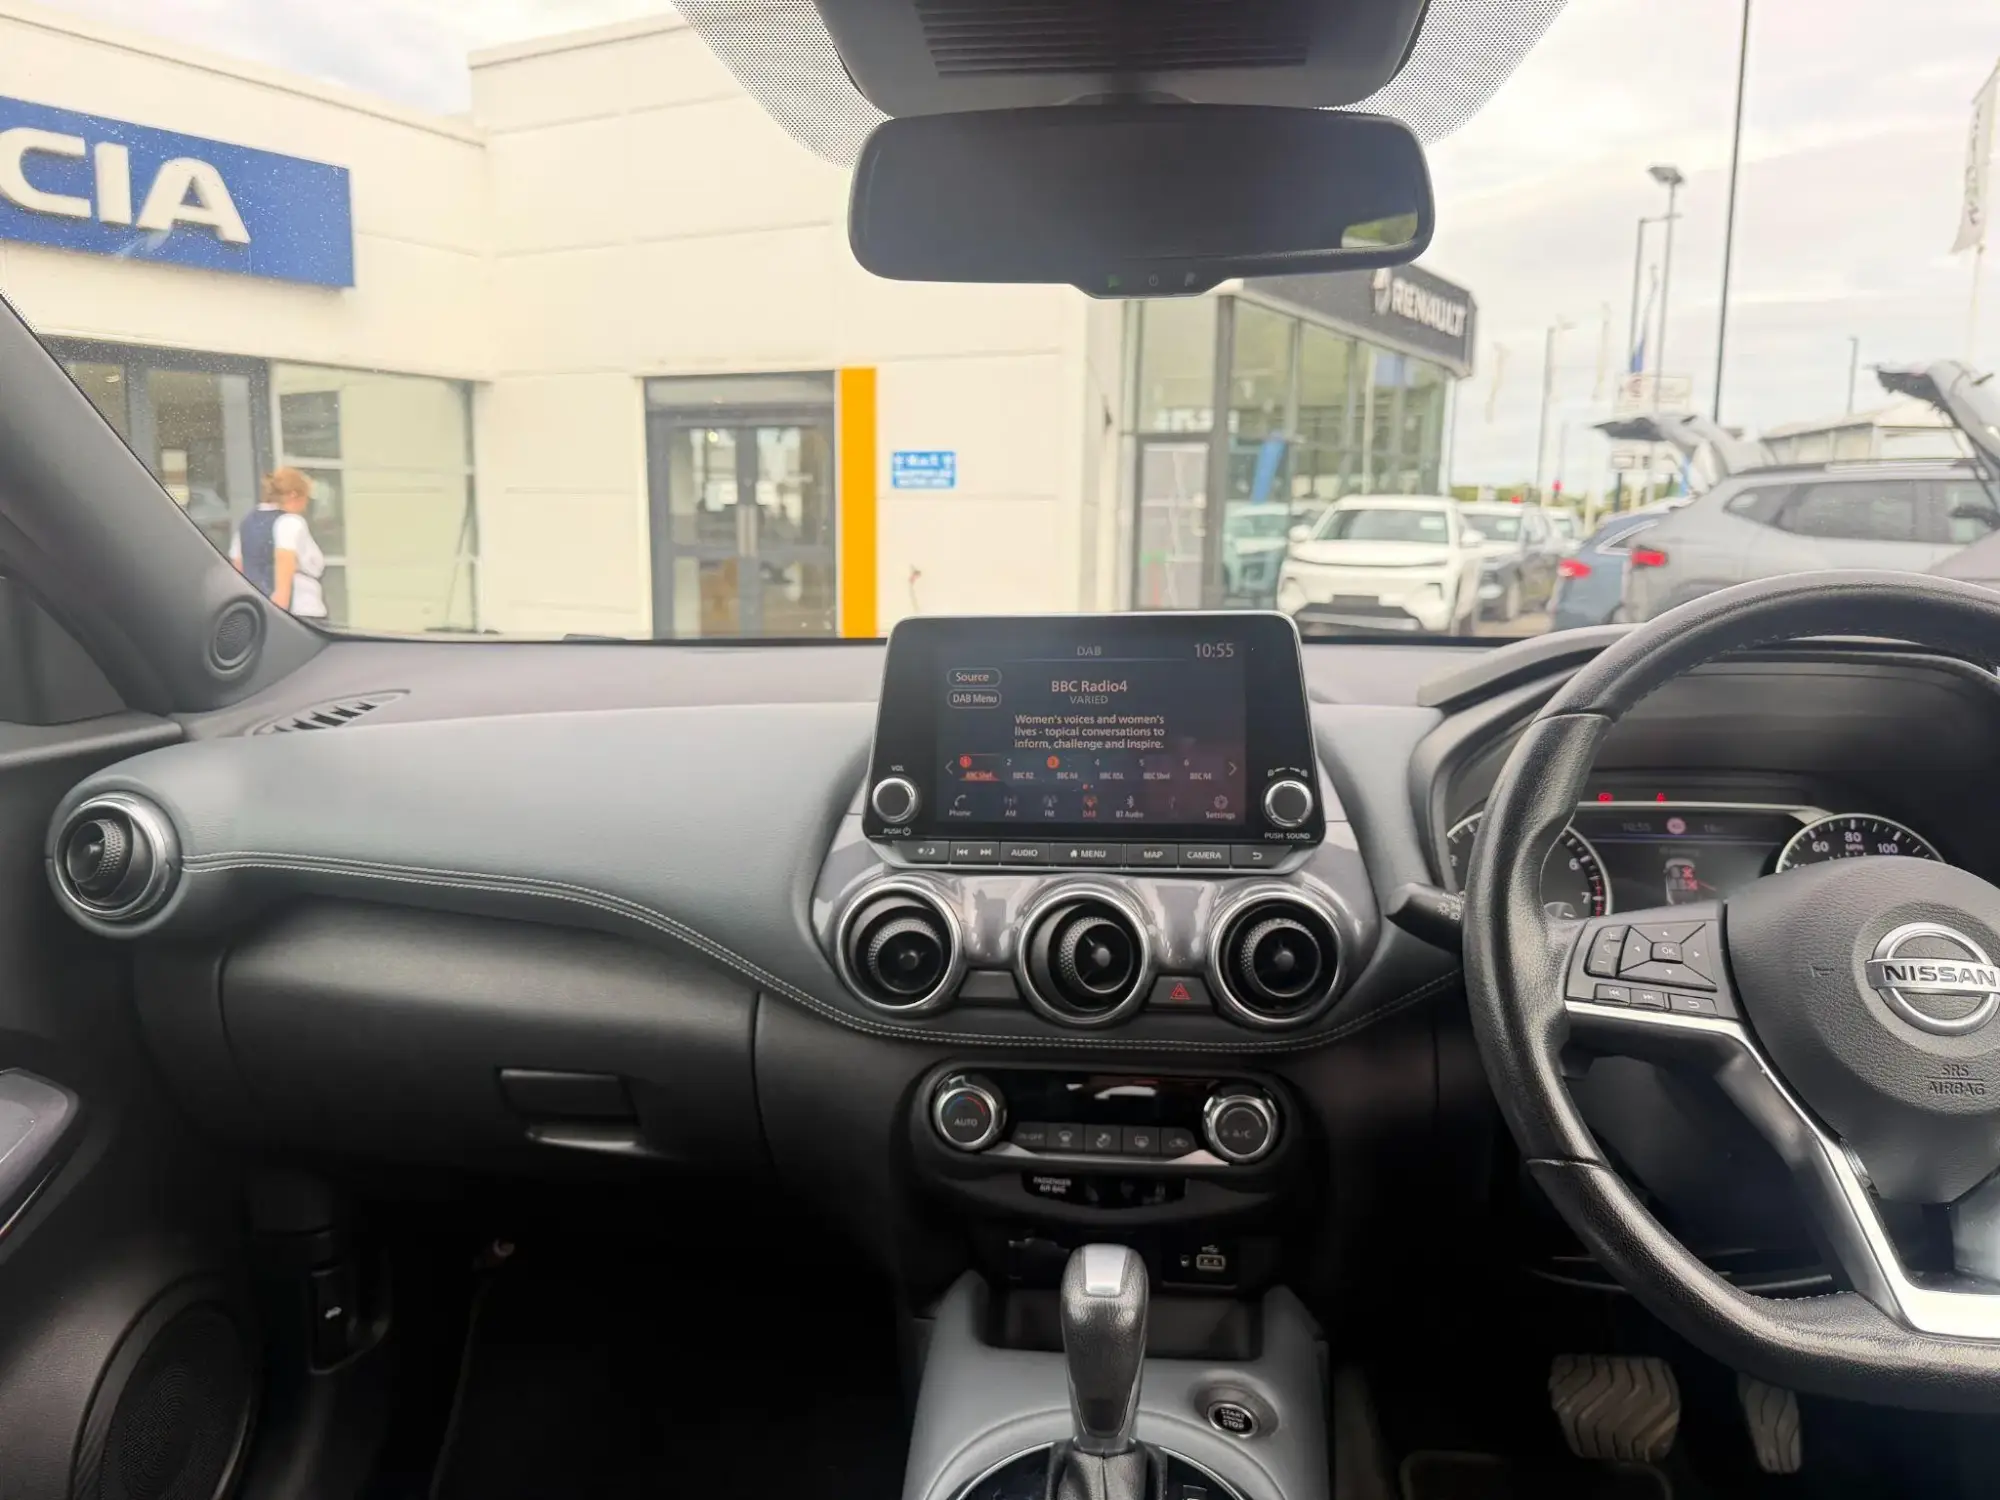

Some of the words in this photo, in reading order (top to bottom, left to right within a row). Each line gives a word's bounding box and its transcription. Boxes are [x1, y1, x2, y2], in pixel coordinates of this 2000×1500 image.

[0, 127, 251, 244] CIA
[1392, 277, 1467, 338] RENAULT
[1076, 645, 1102, 656] DAB
[1194, 642, 1234, 658] 10:55
[955, 672, 990, 683] Source
[1051, 680, 1078, 692] BBC
[1081, 680, 1128, 692] Radio4
[952, 694, 972, 703] DAB
[973, 694, 998, 703] Menu
[1069, 695, 1109, 705] VARIED
[1014, 714, 1062, 725] Women's
[1064, 714, 1095, 725] voices
[1097, 714, 1116, 725] and
[1118, 714, 1165, 725] women's
[1014, 726, 1037, 736] lives
[1045, 726, 1079, 739] topical
[1081, 726, 1151, 737] conversations
[1153, 727, 1165, 737] to
[1014, 738, 1051, 750] inform,
[1053, 738, 1103, 751] challenge
[1105, 738, 1125, 749] and
[948, 809, 972, 817] Phone
[1004, 809, 1017, 817] AM
[1044, 809, 1055, 817] FM
[1083, 810, 1097, 818] DAB
[1124, 810, 1144, 818] Audio
[1205, 811, 1236, 820] Settings
[883, 827, 902, 835] PUSH
[1264, 831, 1284, 840] PUSH
[1286, 831, 1311, 841] SOUND
[1844, 831, 1862, 843] 80
[1811, 840, 1830, 853] 60
[1845, 843, 1864, 851] MPH
[1877, 842, 1899, 854] 100
[1010, 848, 1038, 857] AUDIO
[1080, 849, 1107, 858] MENU
[1143, 850, 1164, 859] MAP
[1186, 851, 1222, 860] CAMERA
[1568, 861, 1580, 872] 6
[1581, 891, 1592, 904] 7
[1661, 945, 1675, 956] OK
[1883, 964, 1997, 988] NISSAN
[1941, 1063, 1970, 1077] SRS
[1928, 1081, 1986, 1096] AIRBAG
[954, 1118, 979, 1127] AUTO
[1232, 1129, 1252, 1139] A/C
[1032, 1176, 1072, 1187] PASSENGER
[1222, 1419, 1245, 1429] STOP
